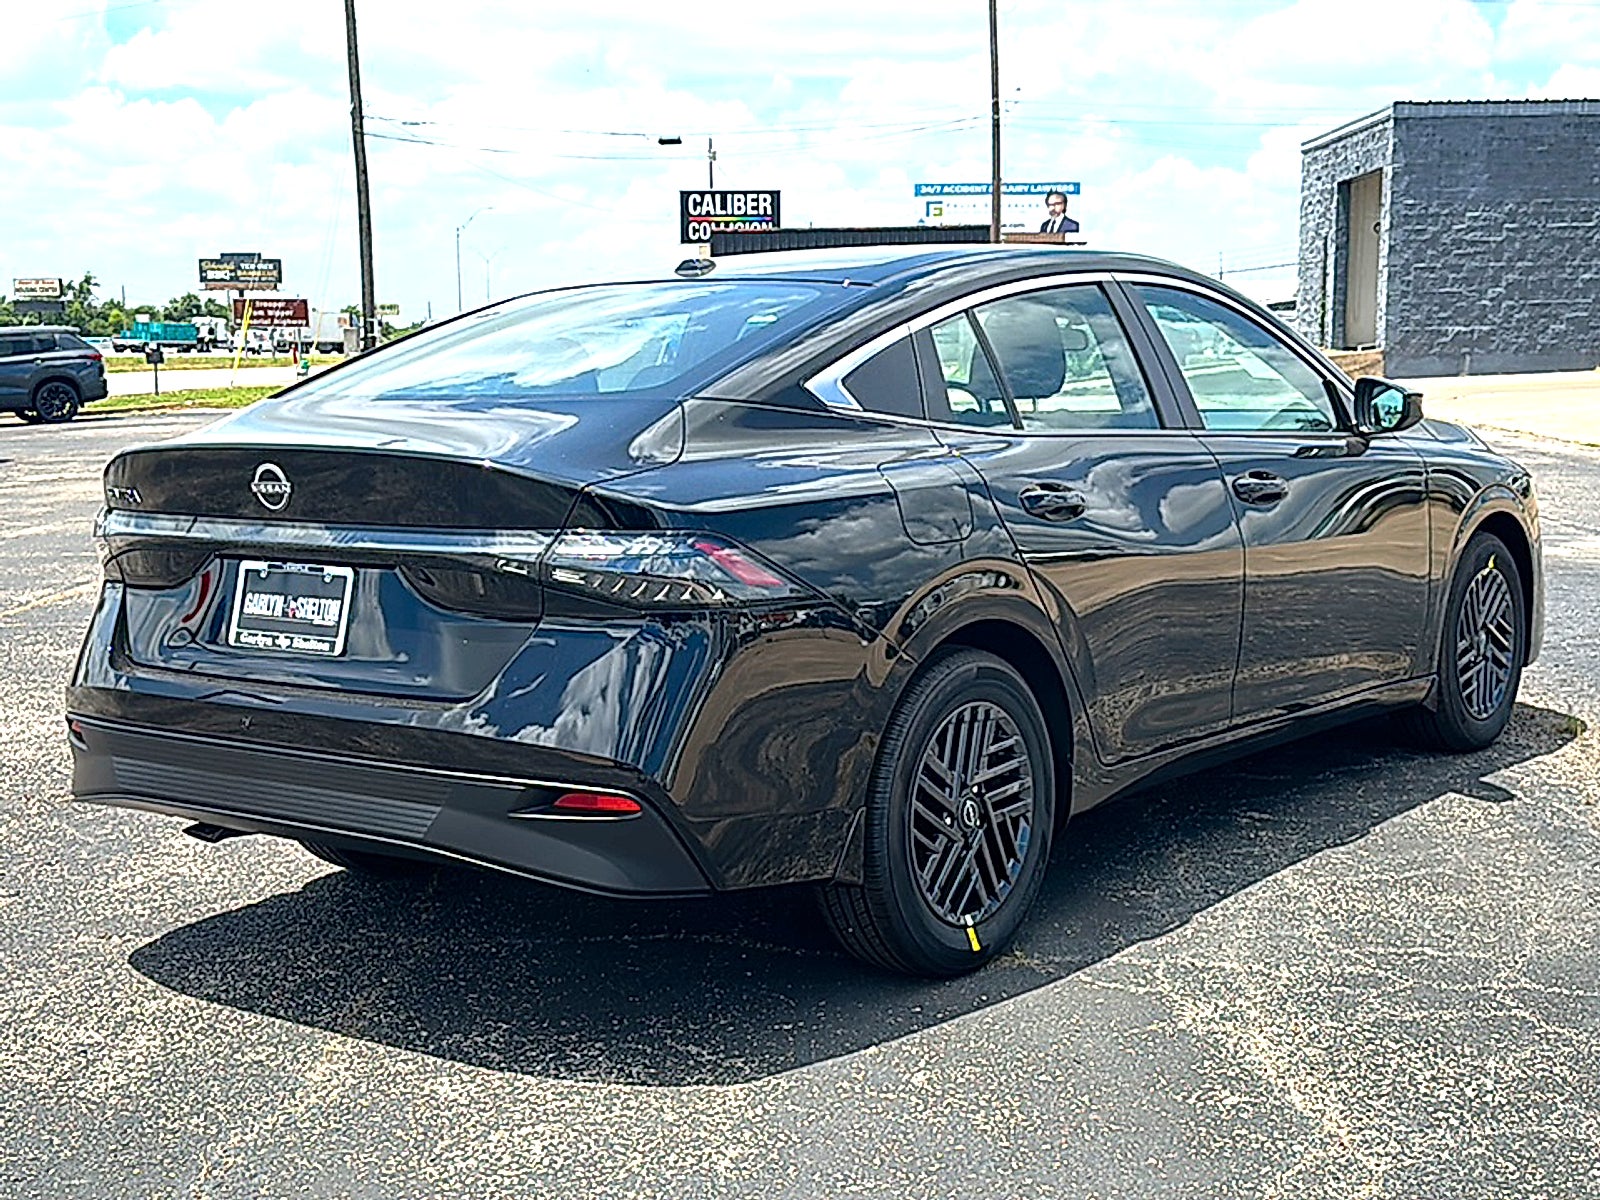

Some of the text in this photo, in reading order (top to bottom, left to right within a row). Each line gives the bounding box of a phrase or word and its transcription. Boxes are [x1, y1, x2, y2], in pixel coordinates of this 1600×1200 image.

[943, 184, 988, 193] ACCIDENT
[688, 193, 772, 215] CALIBER
[251, 481, 292, 494] NISSAN
[243, 592, 342, 621] GARLYN SHELTON
